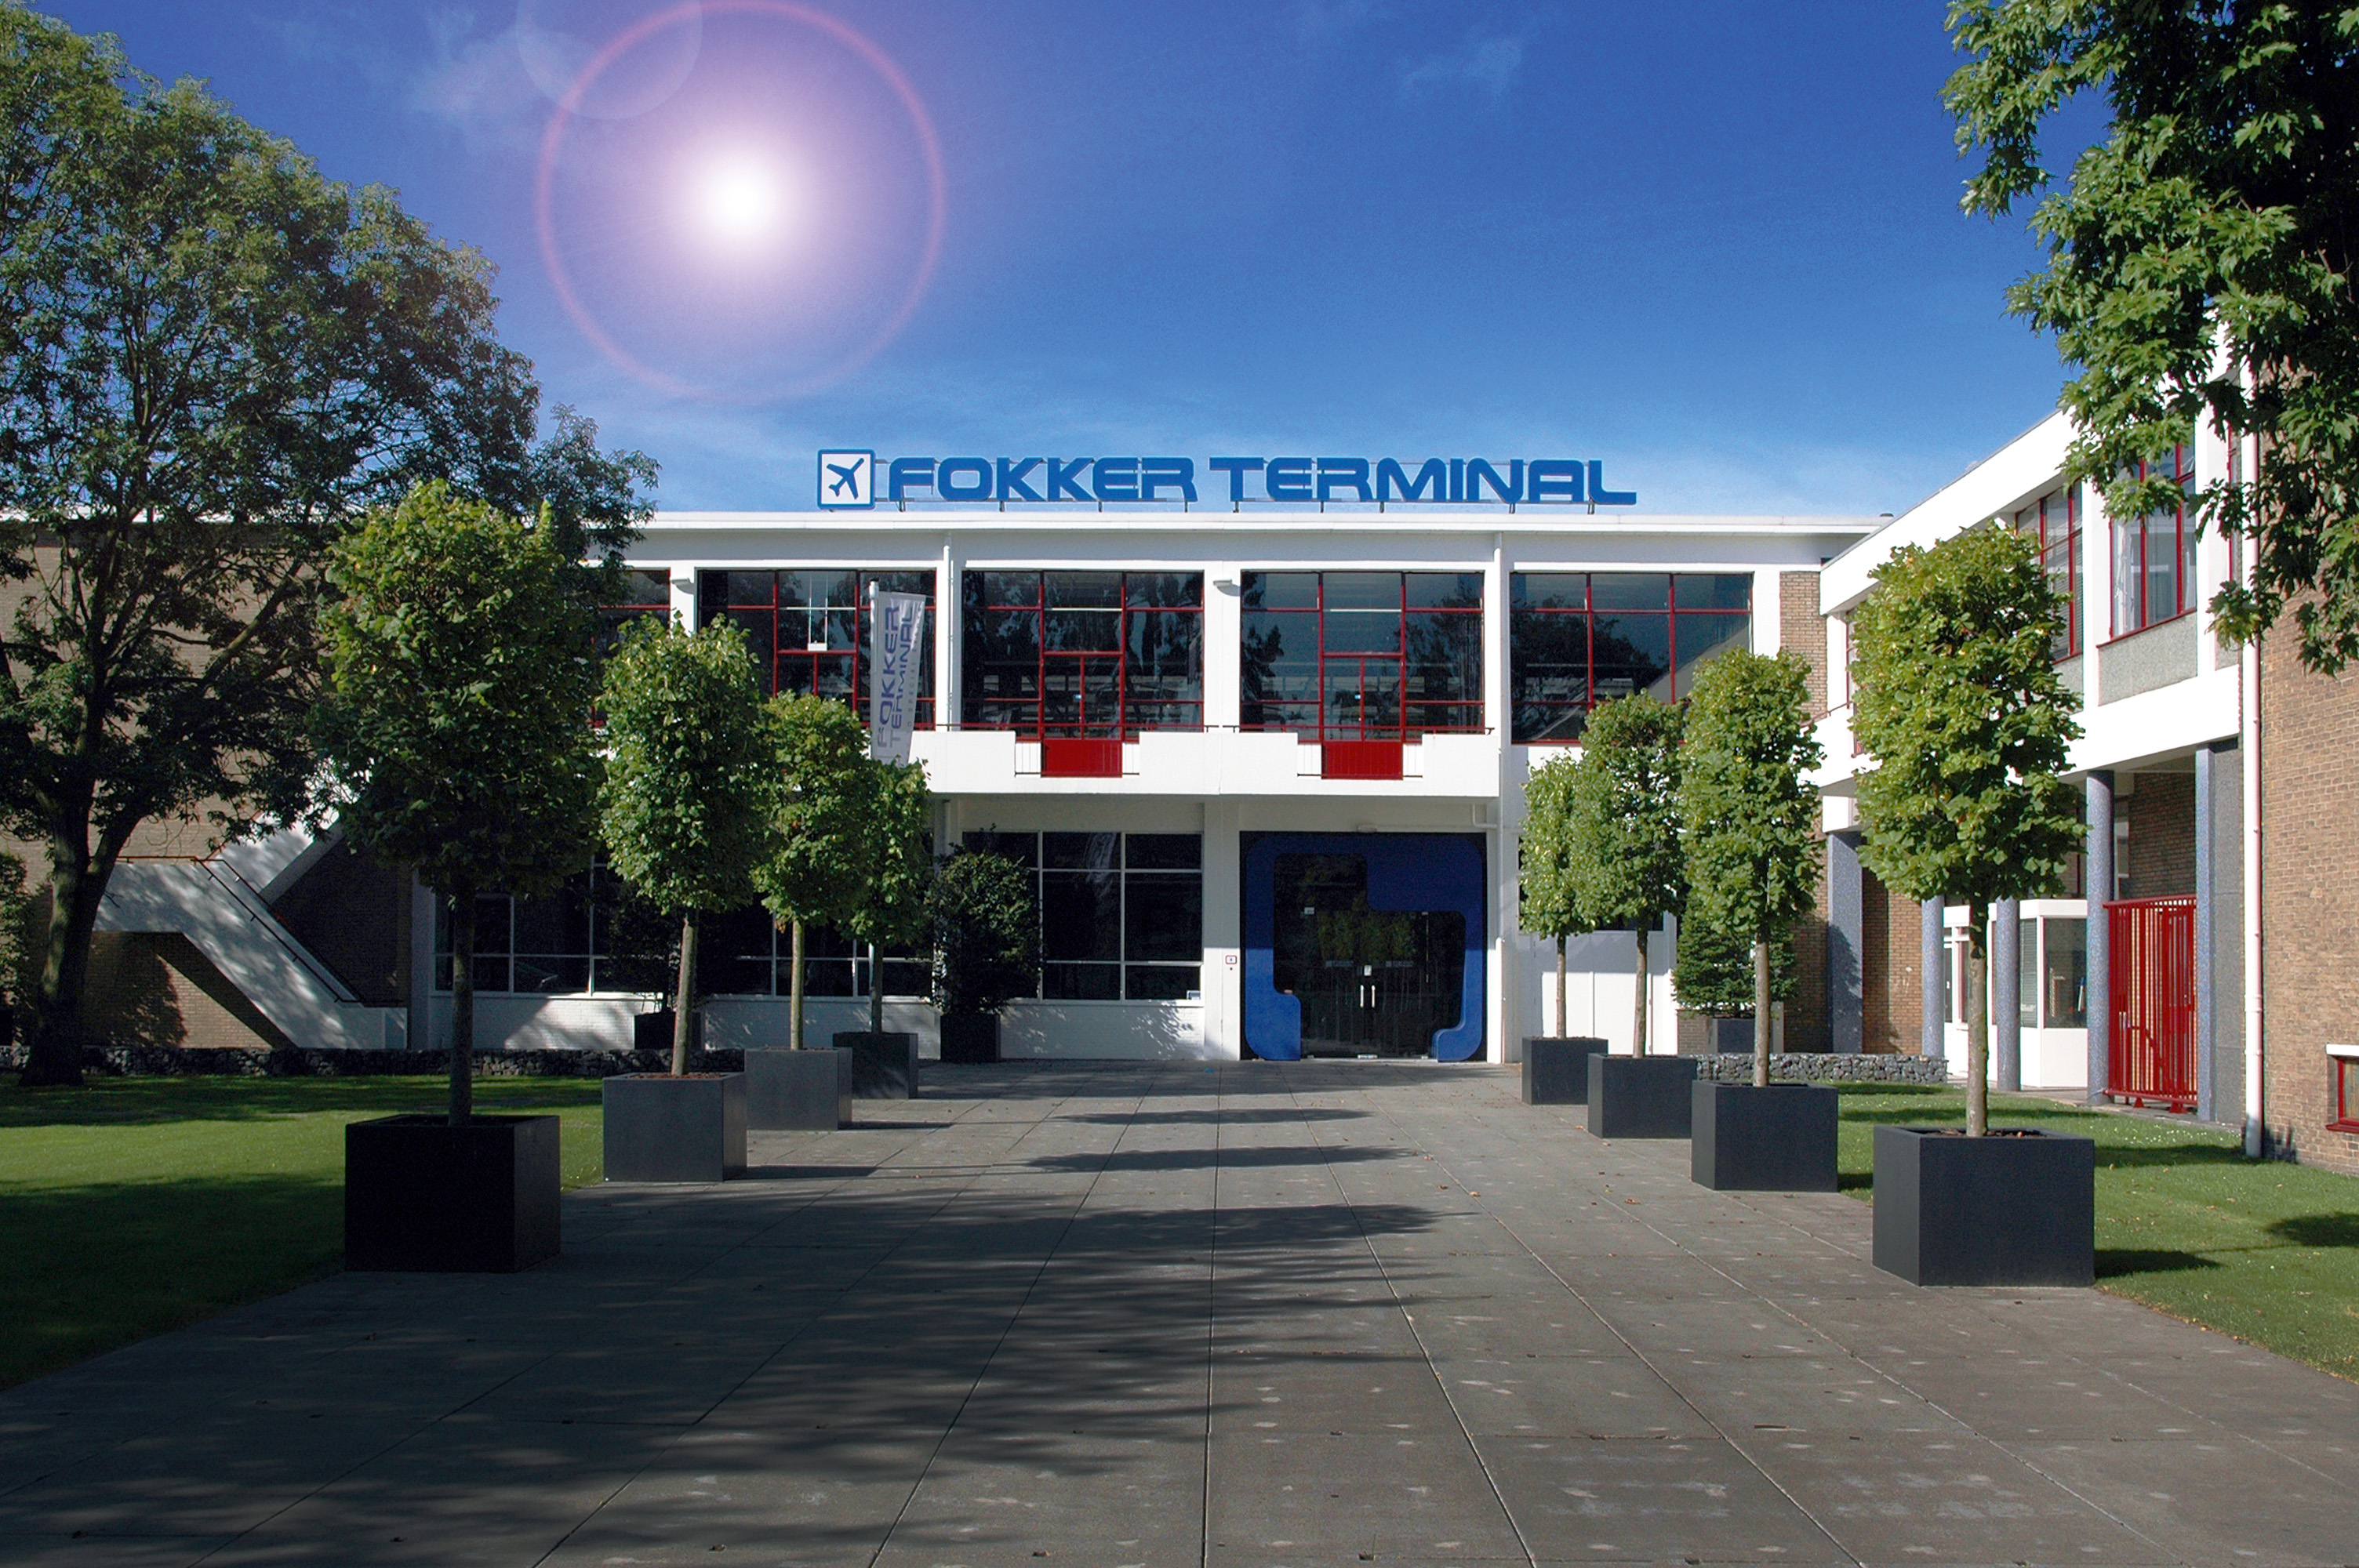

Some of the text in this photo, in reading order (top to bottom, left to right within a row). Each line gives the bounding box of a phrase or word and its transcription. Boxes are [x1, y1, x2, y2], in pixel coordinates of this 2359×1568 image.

[888, 456, 1637, 505] FOKKER TERMINAL
[878, 606, 900, 748] FOKKER
[889, 607, 914, 748] TERMINAL
